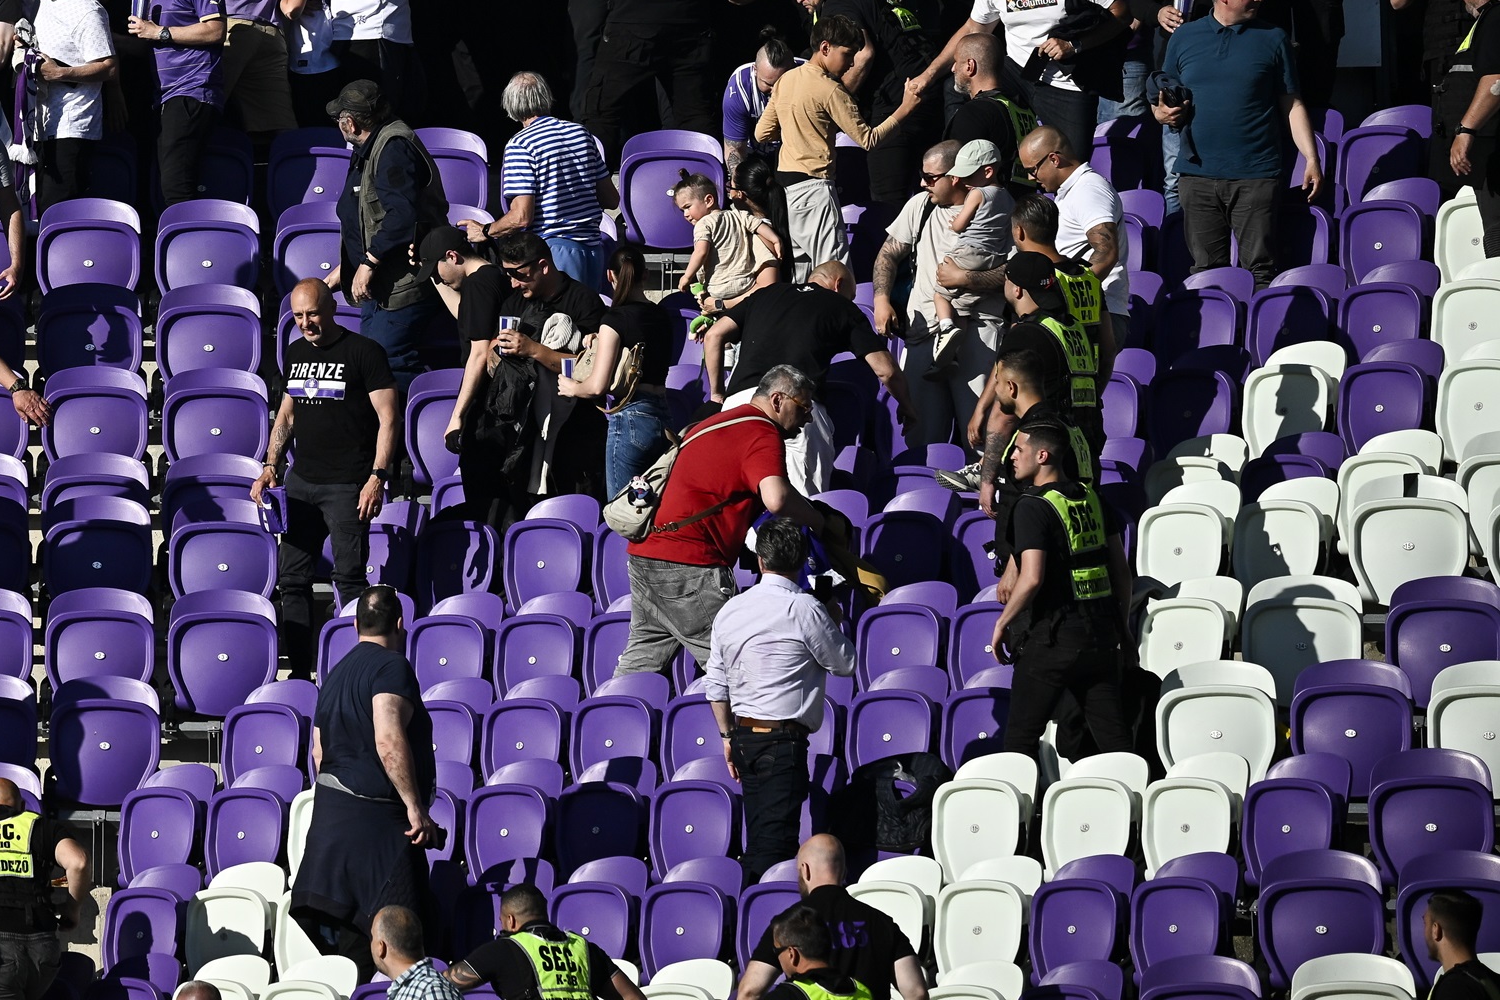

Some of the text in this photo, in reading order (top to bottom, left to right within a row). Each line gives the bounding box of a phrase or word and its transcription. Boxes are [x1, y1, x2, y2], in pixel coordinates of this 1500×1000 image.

[289, 362, 345, 381] FIRENZE
[1068, 503, 1100, 535] SEC.
[538, 945, 582, 974] SEC.
